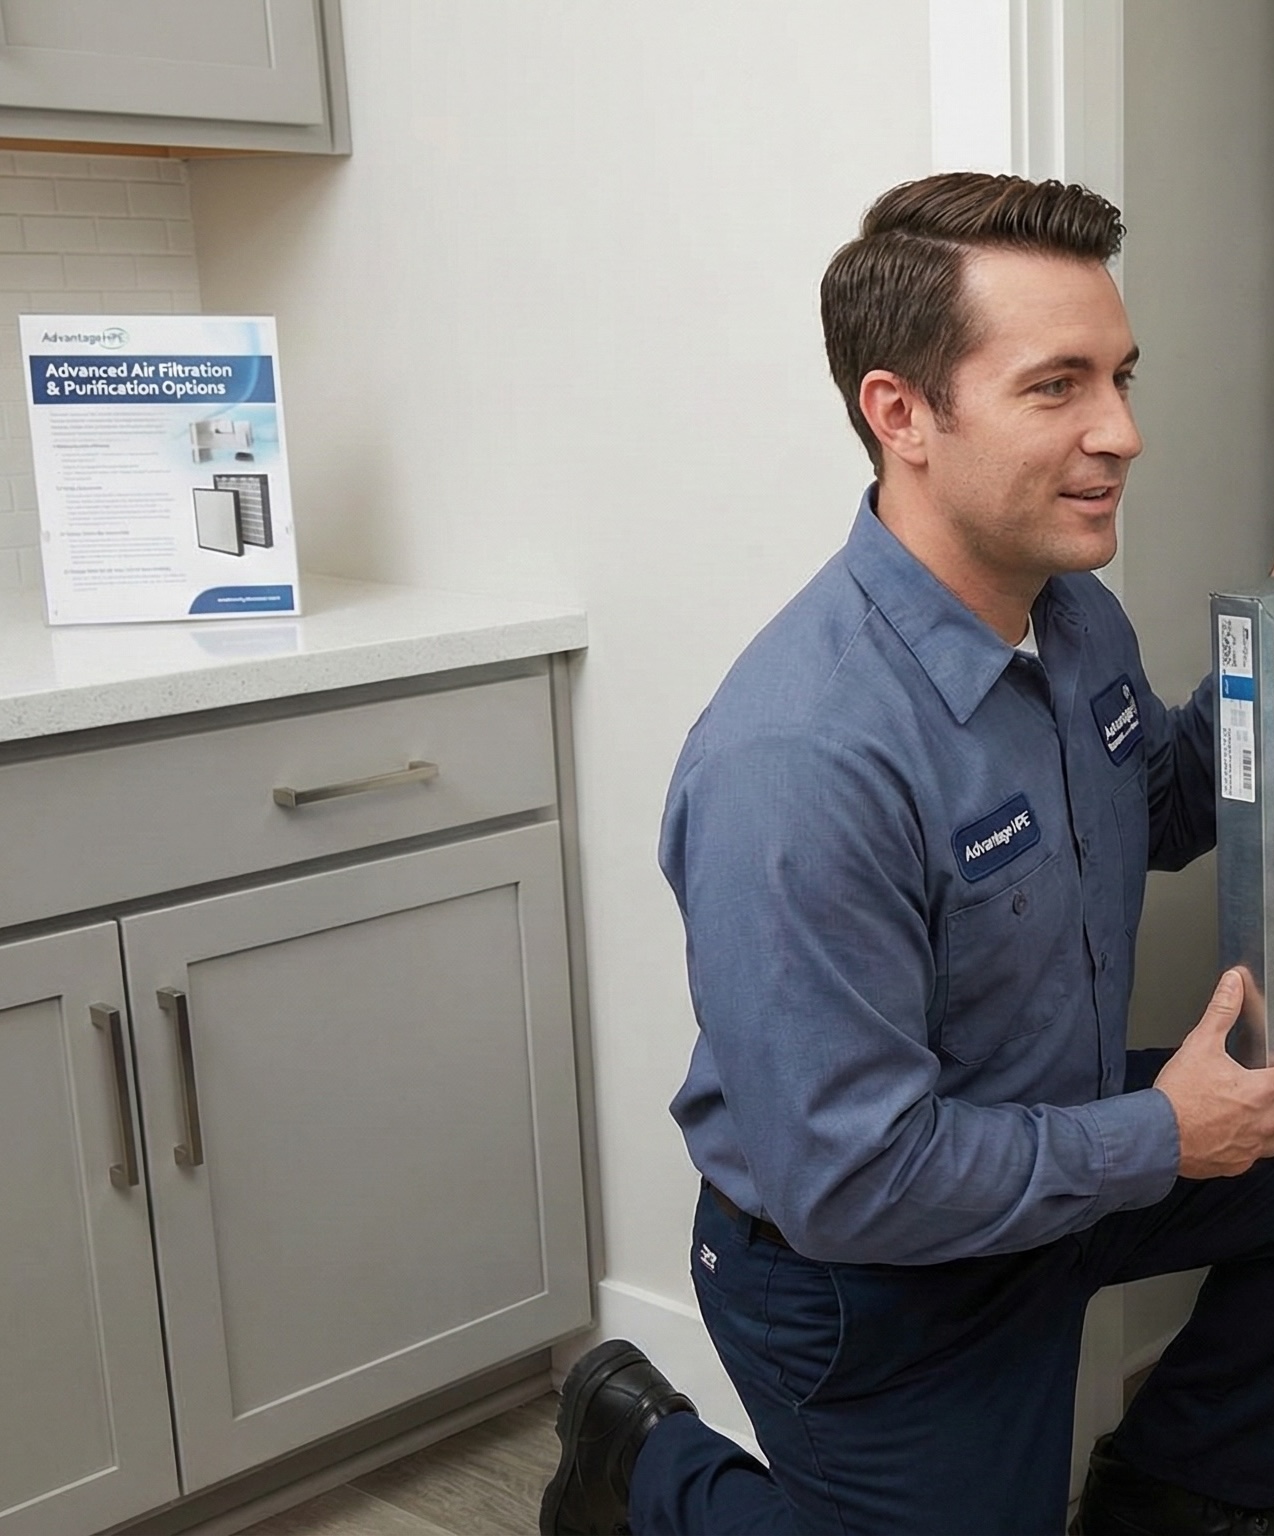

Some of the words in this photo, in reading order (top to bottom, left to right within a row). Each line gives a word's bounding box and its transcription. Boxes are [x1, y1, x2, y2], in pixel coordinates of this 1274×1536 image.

[46, 362, 127, 378] Advanced
[131, 362, 155, 377] Air
[159, 362, 232, 377] Filtration
[46, 381, 60, 396] &
[64, 380, 159, 396] Purification
[162, 382, 226, 399] Options
